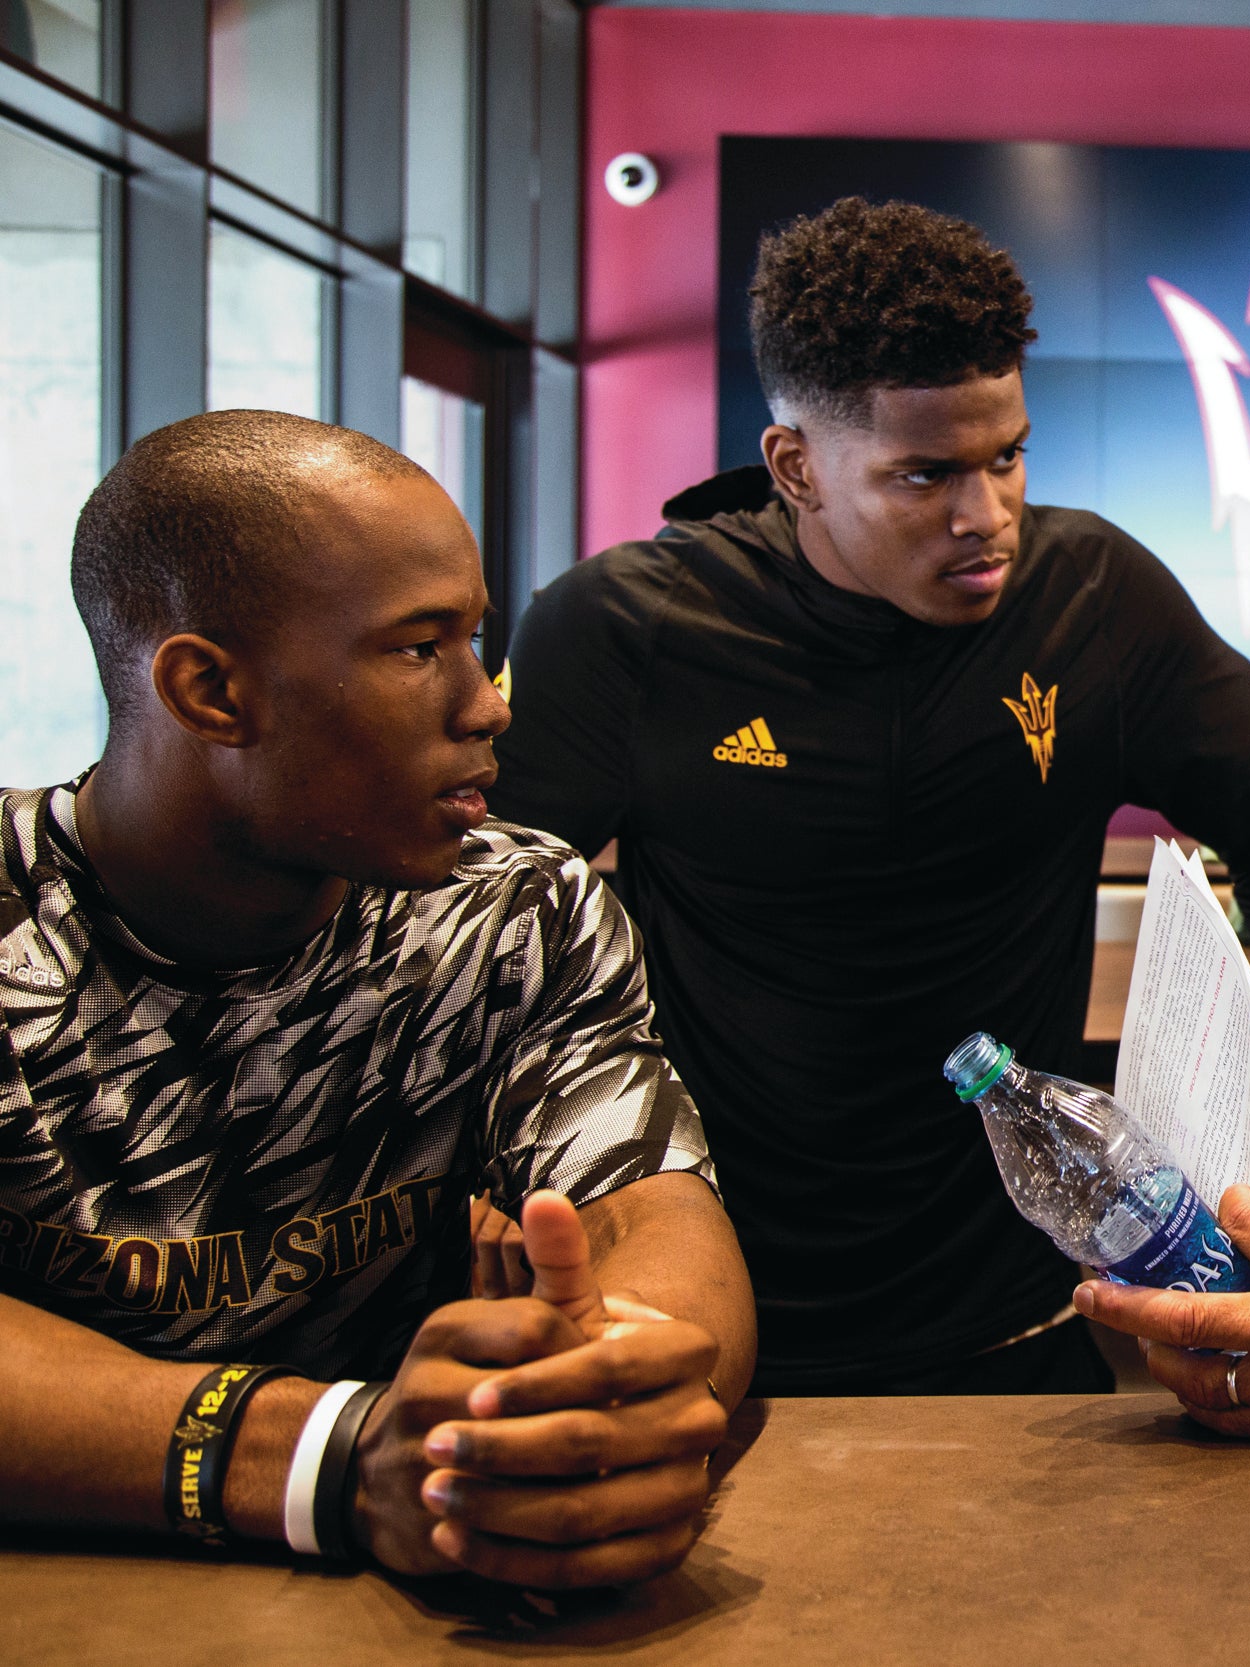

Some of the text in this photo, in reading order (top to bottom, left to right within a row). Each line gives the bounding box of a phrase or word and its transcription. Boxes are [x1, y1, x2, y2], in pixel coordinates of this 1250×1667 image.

[713, 745, 788, 768] adidas
[1218, 956, 1226, 981] WHY
[1207, 1002, 1215, 1024] YOU
[1200, 1024, 1209, 1049] TAKE
[1194, 1050, 1202, 1072] THIS
[1187, 1071, 1196, 1098] JOB?
[1164, 1187, 1193, 1239] PURIFIED WATER
[1144, 1249, 1169, 1271] ENHANCED
[1167, 1237, 1180, 1251] WITH
[1177, 1216, 1193, 1239] MINERALS
[181, 1448, 203, 1519] SERVE
